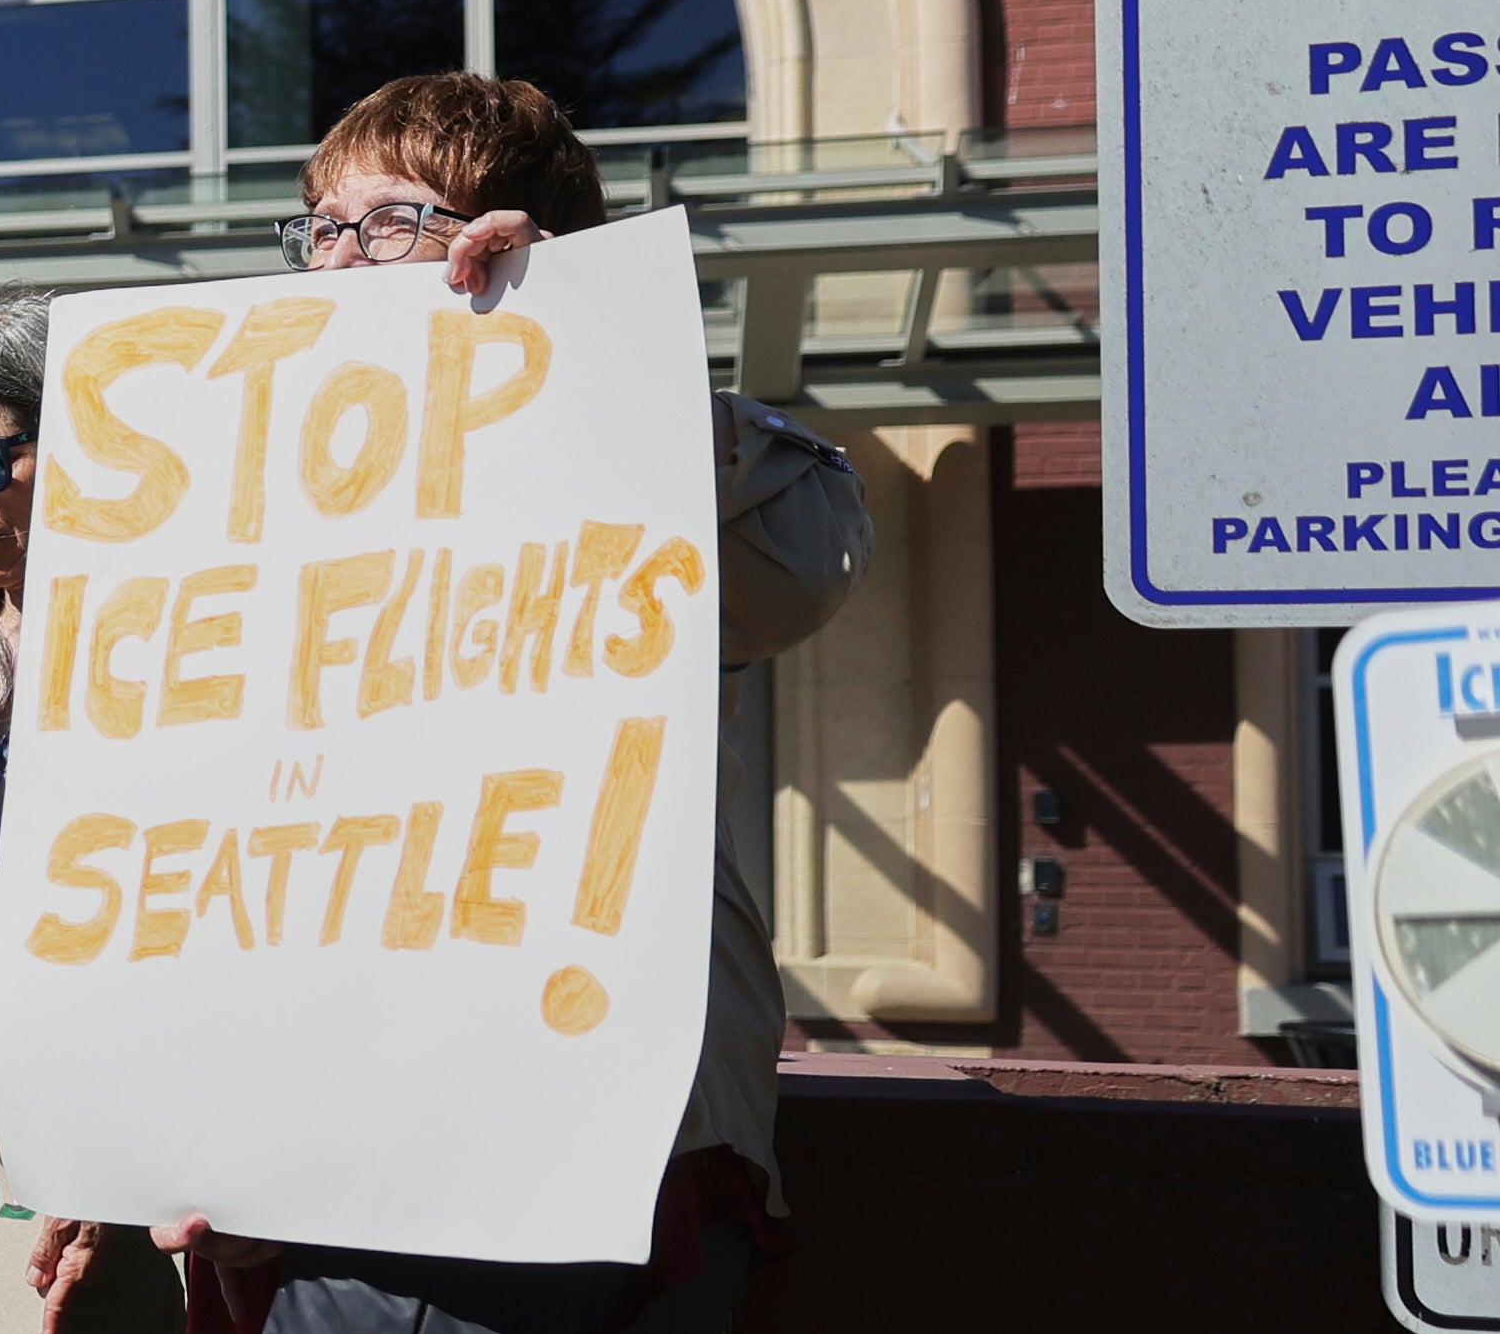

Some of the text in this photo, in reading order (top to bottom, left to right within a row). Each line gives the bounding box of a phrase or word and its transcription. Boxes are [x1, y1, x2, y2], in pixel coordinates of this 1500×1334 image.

[1308, 32, 1500, 96] PAS
[1263, 116, 1460, 180] ARE
[1304, 201, 1434, 259] TO
[42, 296, 554, 544] STOP
[1405, 363, 1500, 420] AI
[1212, 511, 1500, 554] PARKING
[37, 518, 707, 739] ICE FLIGHTS
[269, 752, 326, 801] IN
[24, 714, 668, 1037] SEATTLE!
[1412, 1139, 1494, 1170] BLUE
